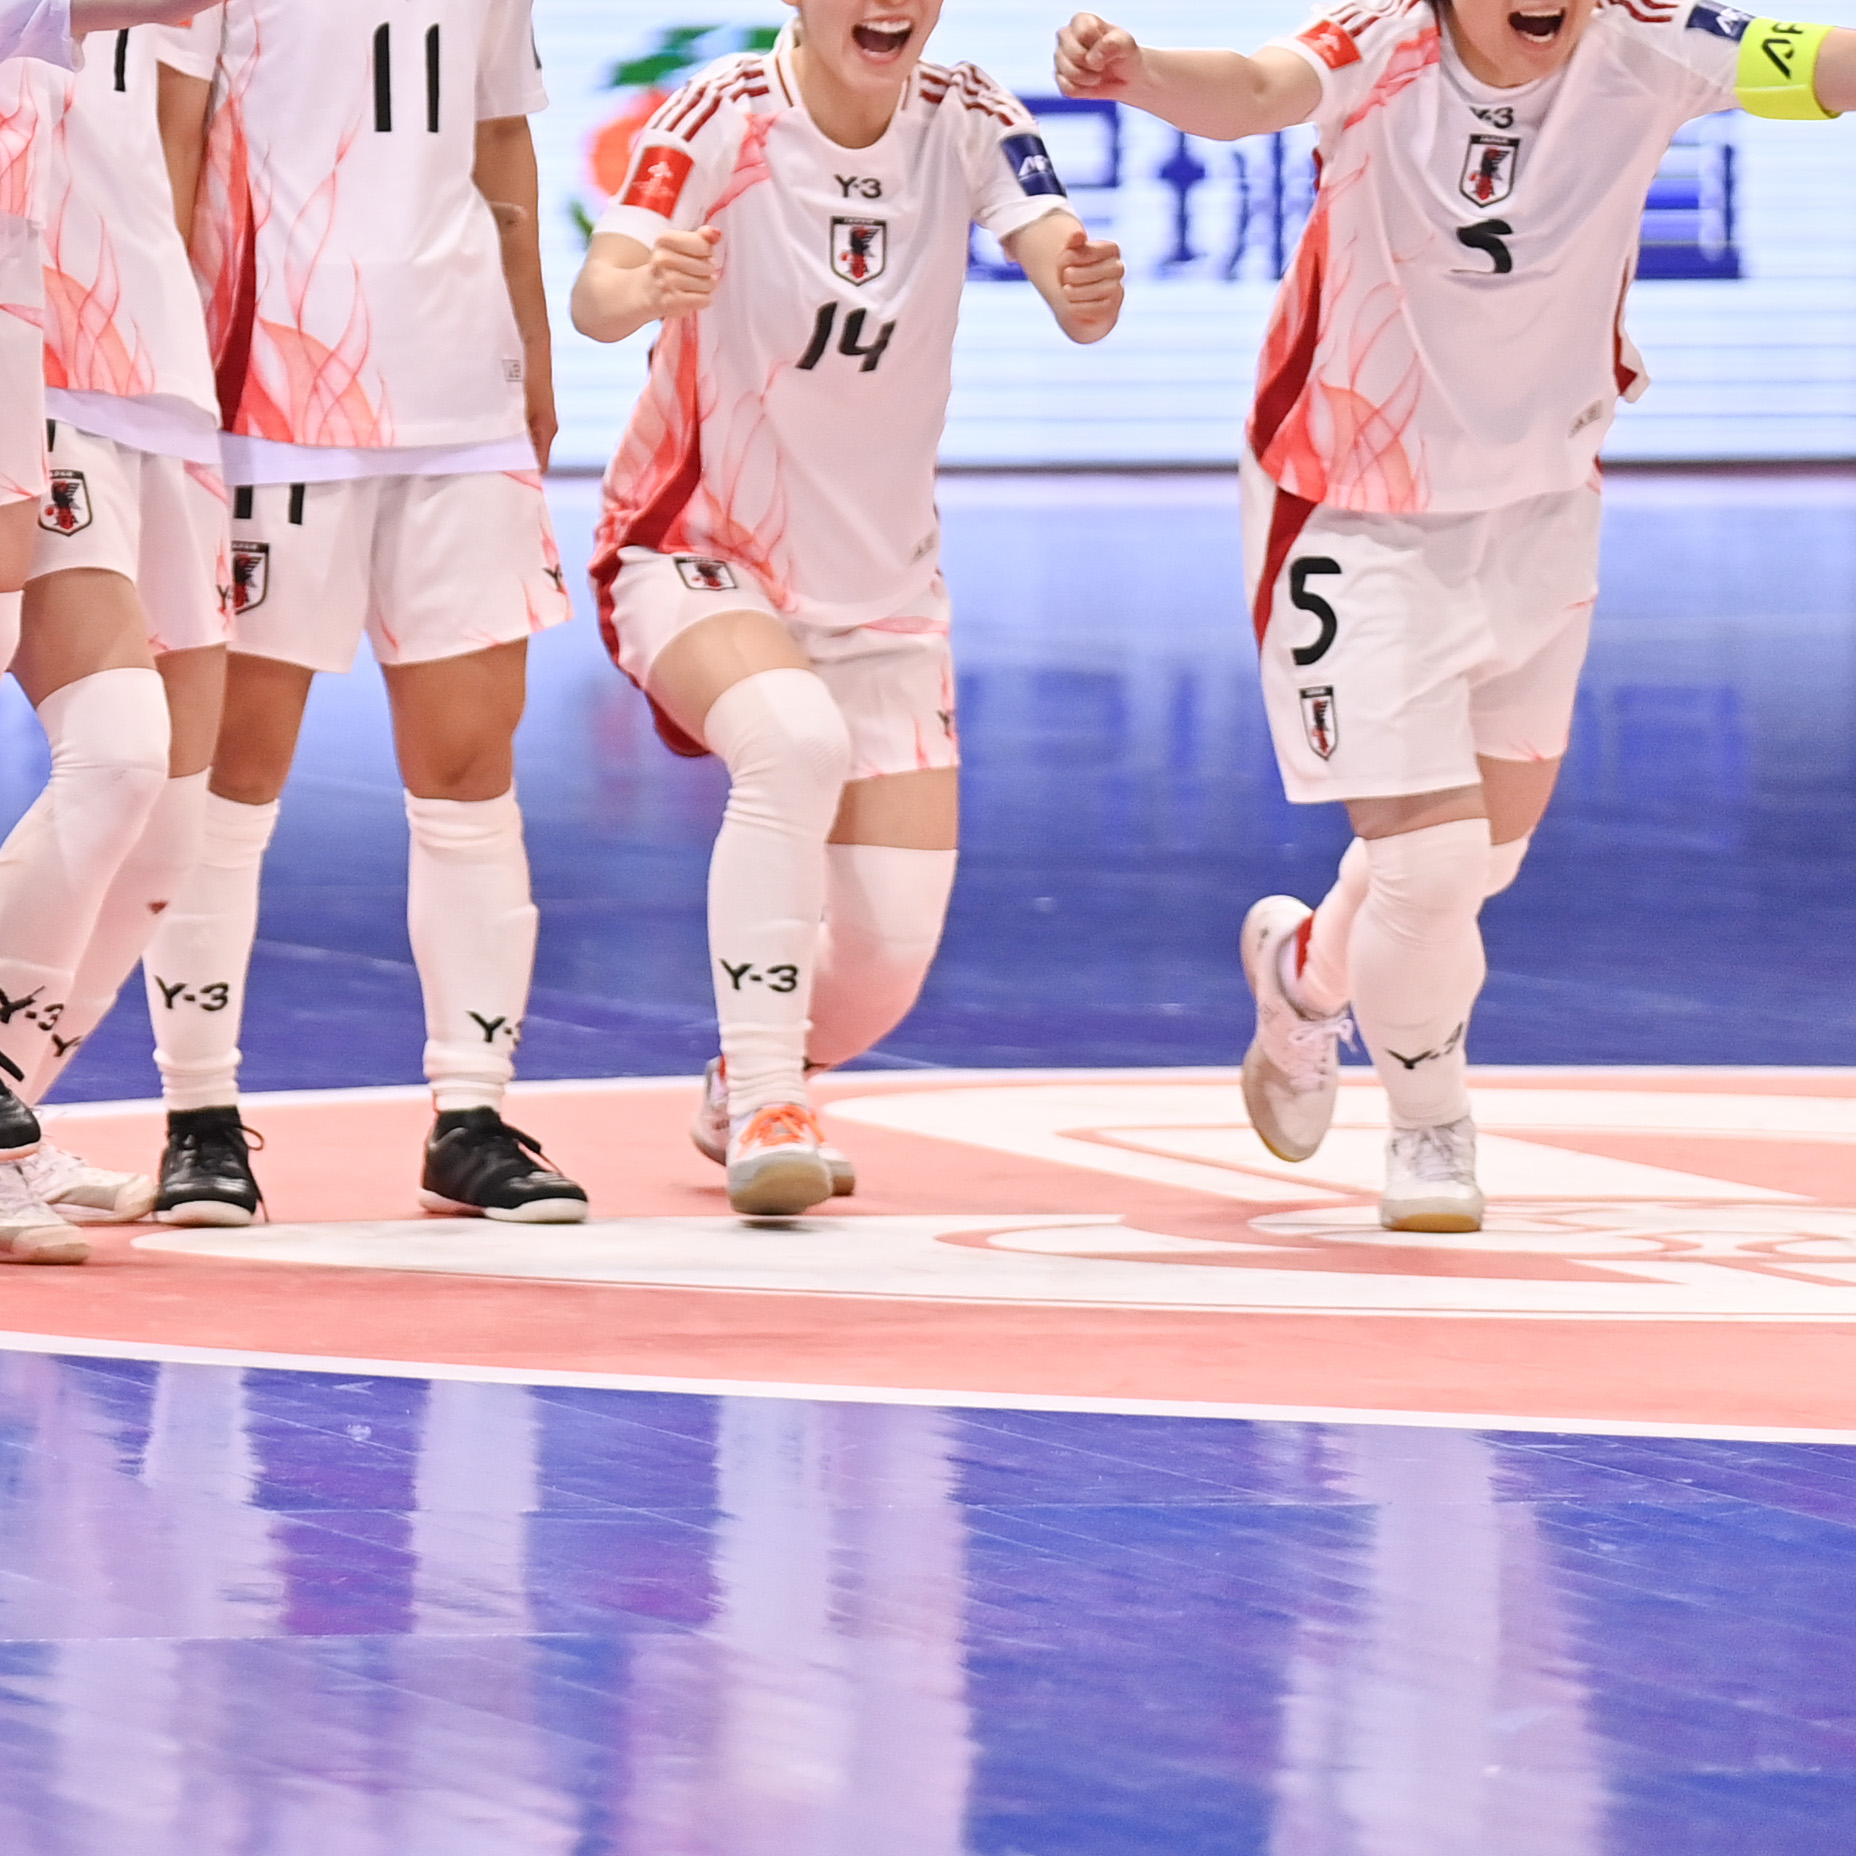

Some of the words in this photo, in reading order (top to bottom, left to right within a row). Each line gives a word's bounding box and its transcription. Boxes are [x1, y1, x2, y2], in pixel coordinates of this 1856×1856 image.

[373, 21, 440, 134] 11
[834, 173, 882, 200] Y-3
[794, 300, 897, 373] 14
[1289, 556, 1343, 666] 5
[155, 975, 230, 1012] Y-3
[719, 958, 799, 993] Y-3
